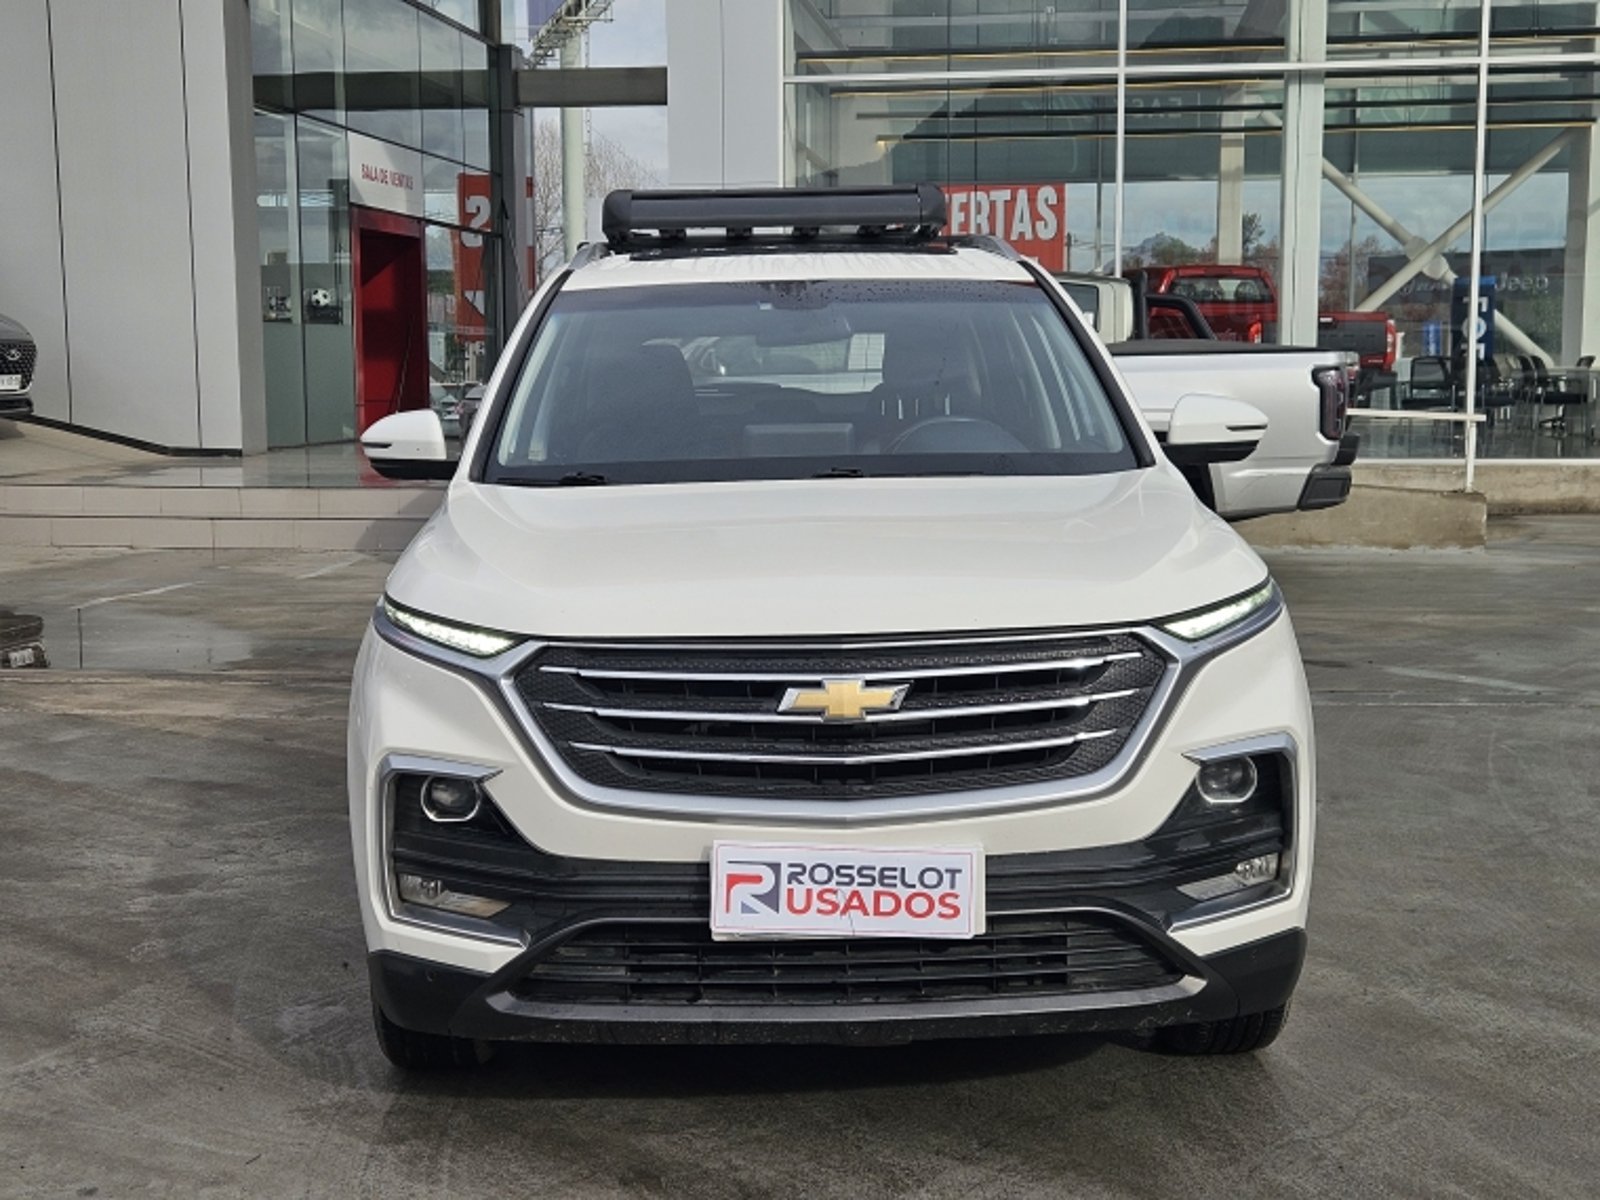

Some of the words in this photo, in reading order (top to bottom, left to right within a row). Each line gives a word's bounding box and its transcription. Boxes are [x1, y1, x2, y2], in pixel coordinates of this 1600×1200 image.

[361, 163, 379, 182] SALA
[379, 168, 388, 185] DE
[389, 170, 414, 190] VENTAS
[945, 185, 1058, 240] ERTAS
[787, 862, 962, 890] ROSSELOT
[786, 887, 961, 919] USADOS
